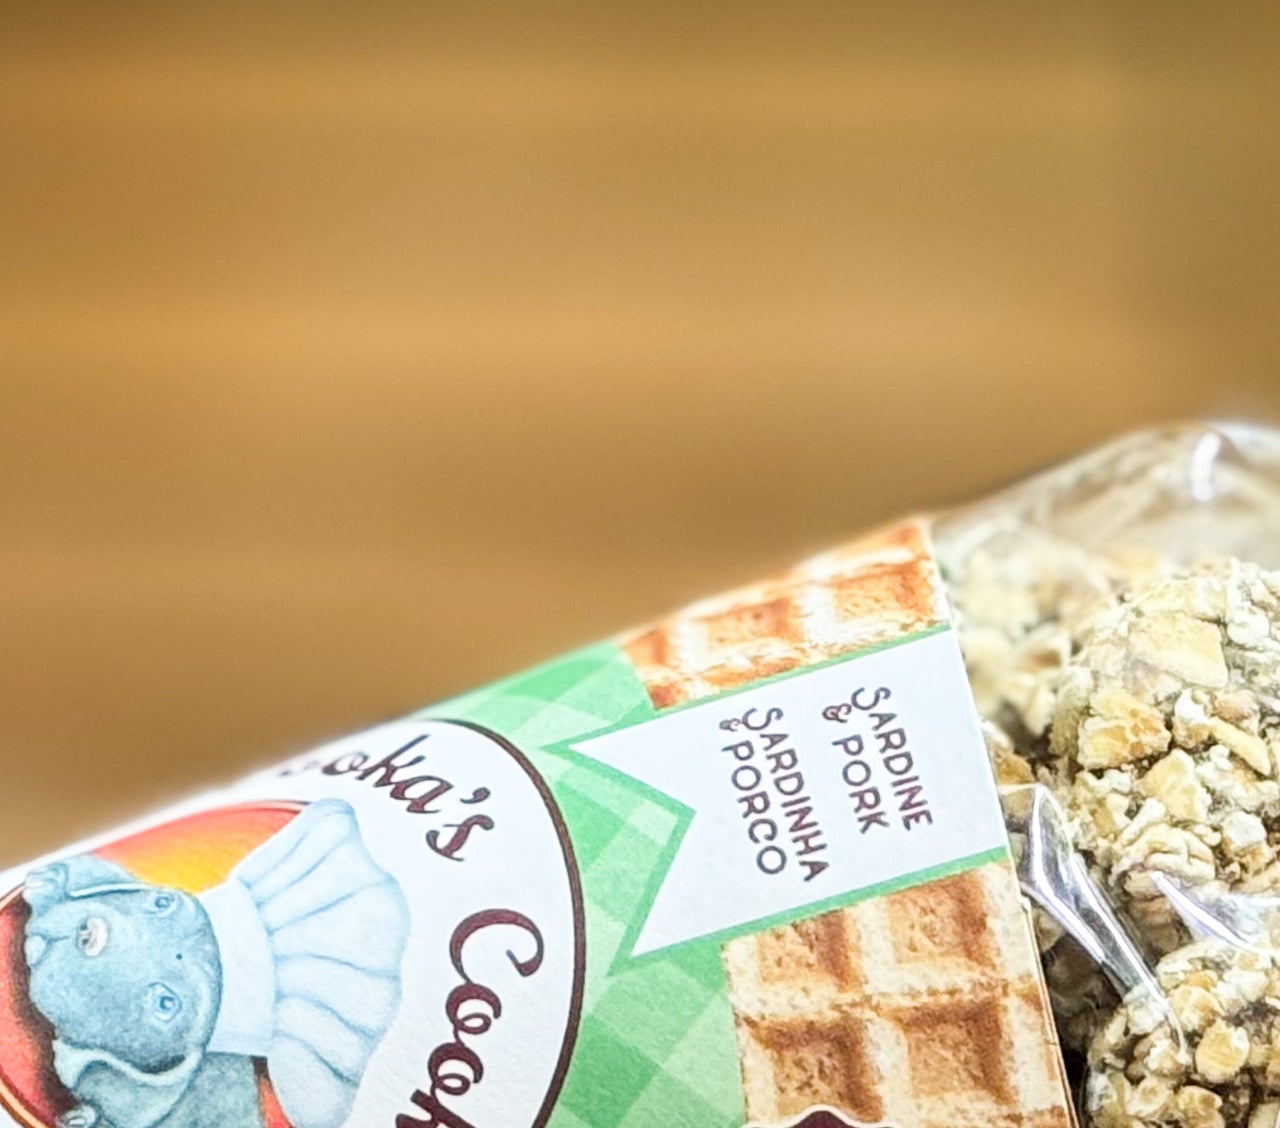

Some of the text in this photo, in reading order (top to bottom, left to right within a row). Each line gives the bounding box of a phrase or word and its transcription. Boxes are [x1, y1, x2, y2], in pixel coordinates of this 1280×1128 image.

[721, 741, 787, 875] PORCO
[742, 707, 830, 882] SARDINHA
[832, 735, 890, 834] PORK
[850, 687, 933, 831] SARDINE
